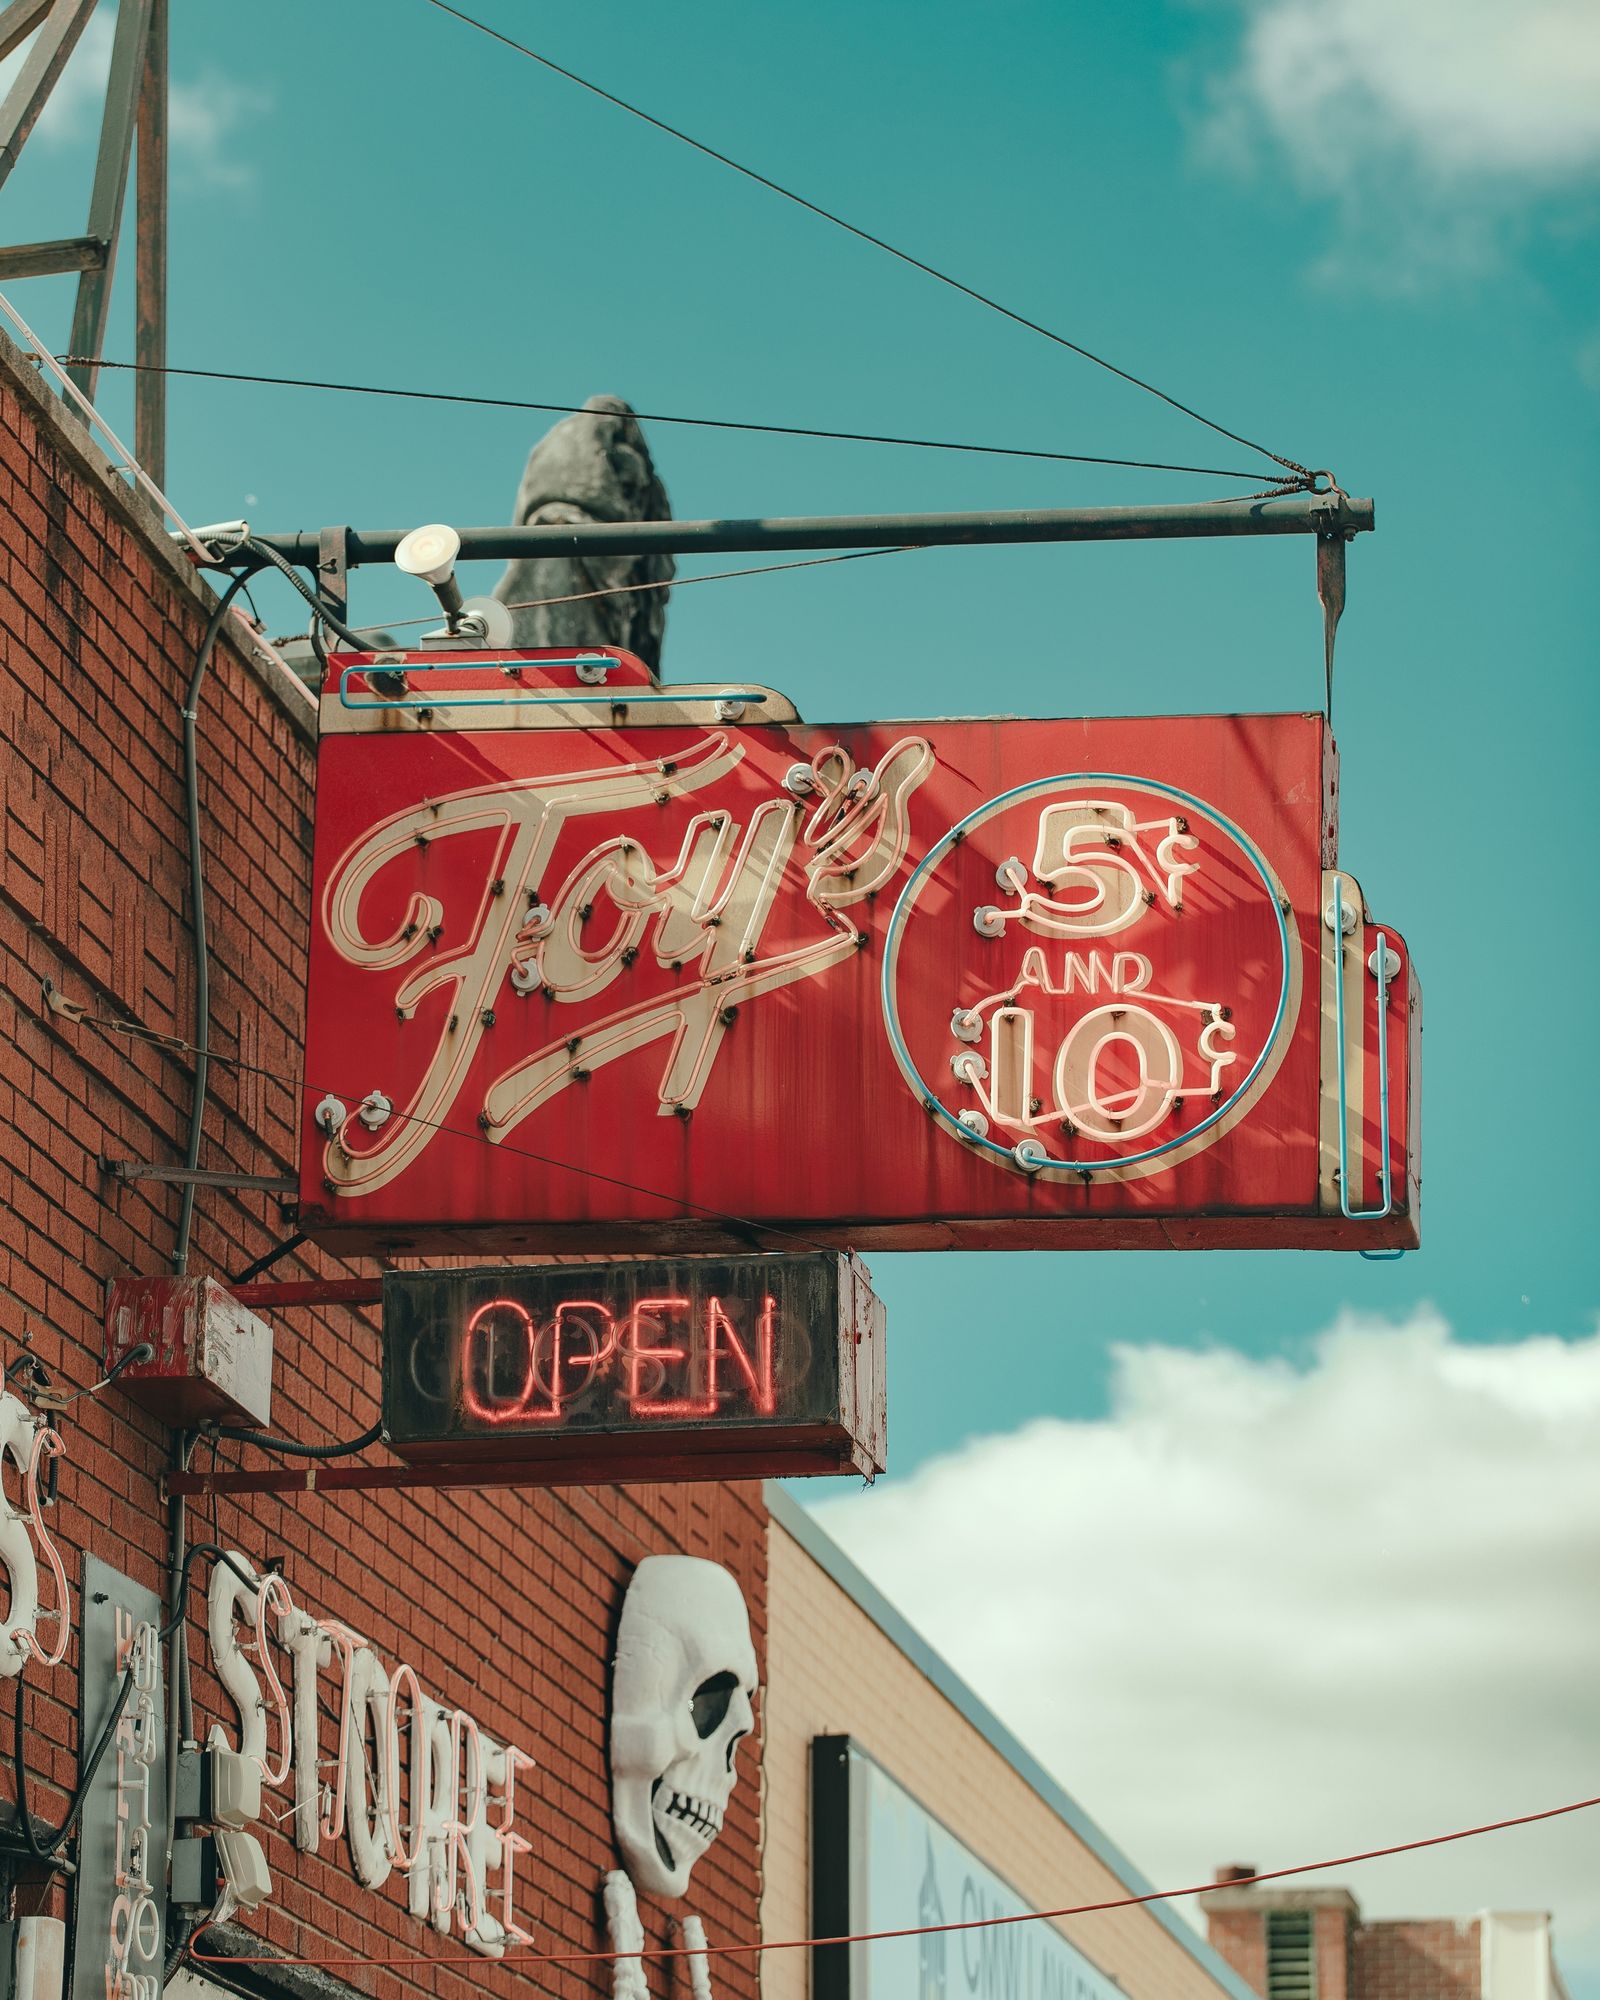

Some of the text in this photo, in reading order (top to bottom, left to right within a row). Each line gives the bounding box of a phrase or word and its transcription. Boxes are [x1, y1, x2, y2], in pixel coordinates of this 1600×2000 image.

[1018, 799, 1200, 939] 5¢
[1021, 946, 1153, 995] AND
[988, 1002, 1237, 1143] 10¢
[462, 1295, 778, 1424] OPEN
[209, 1550, 537, 1958] STORE
